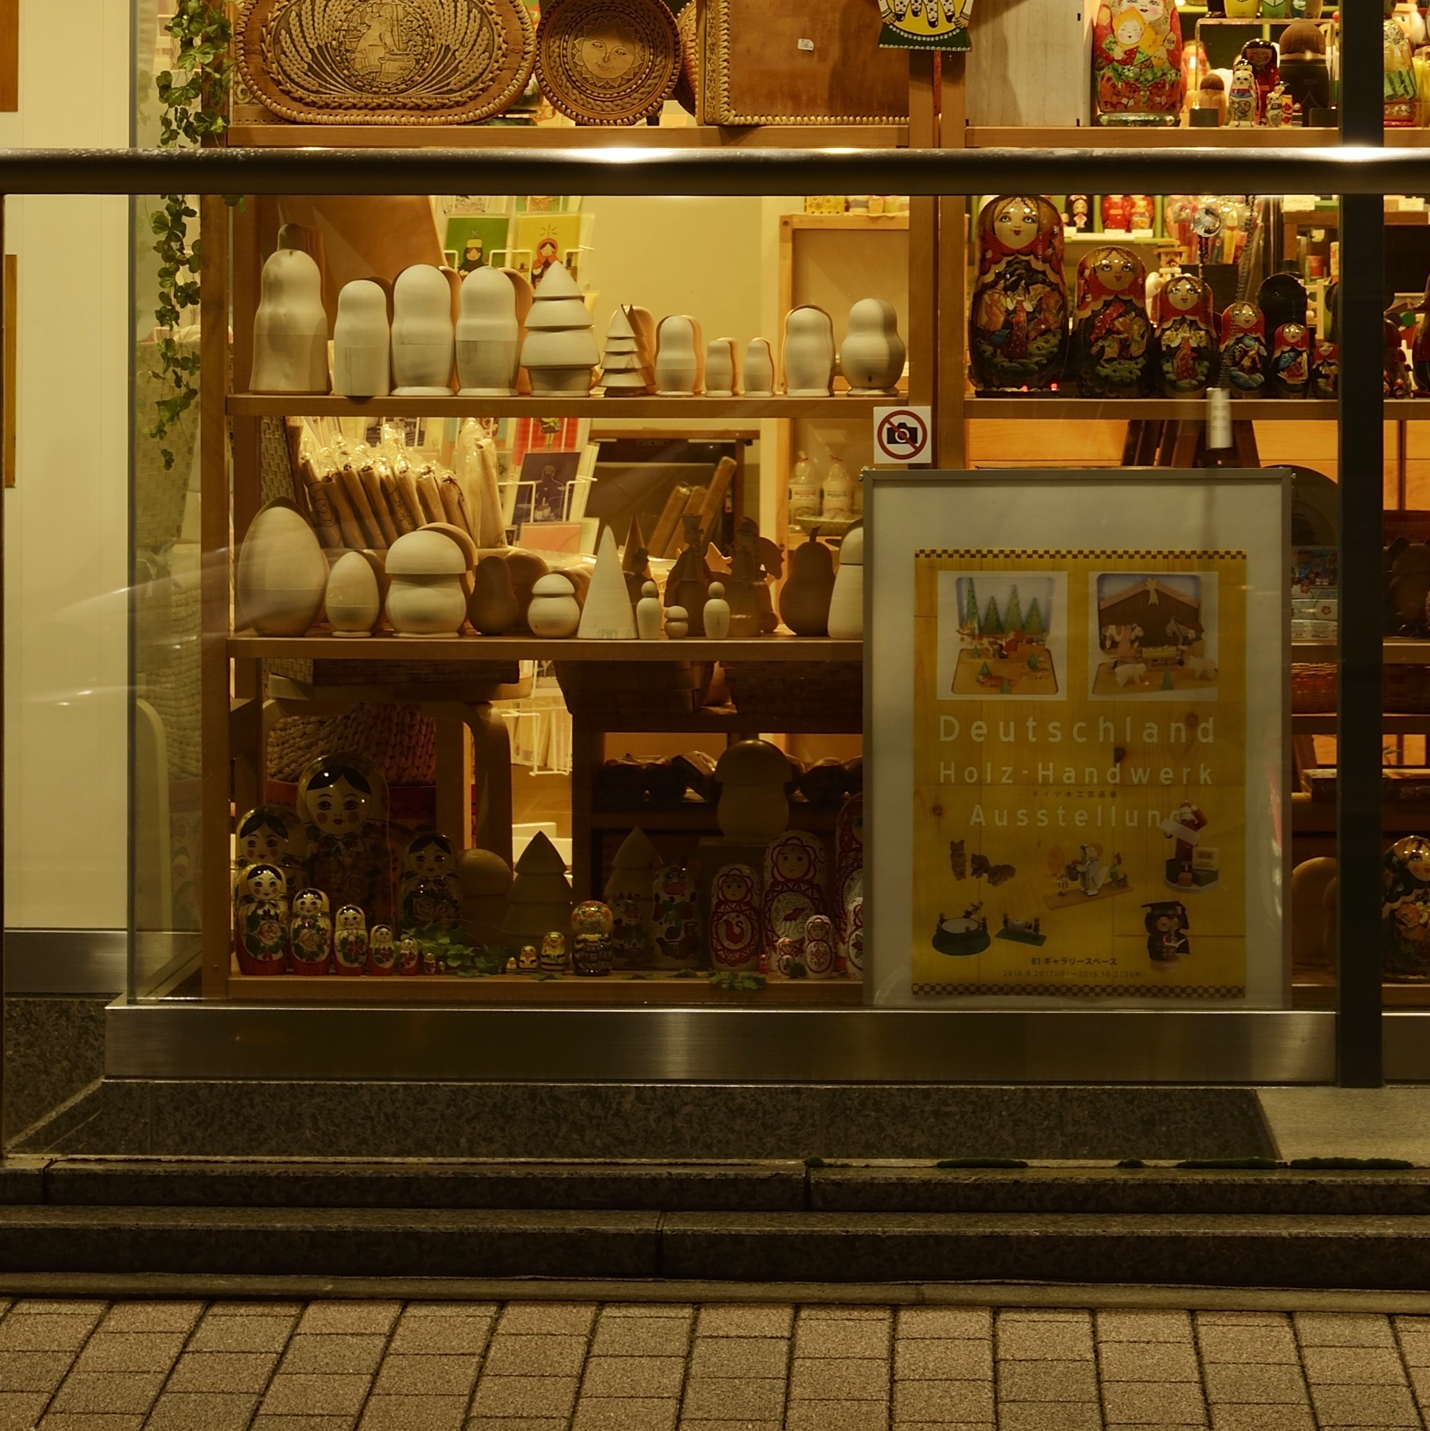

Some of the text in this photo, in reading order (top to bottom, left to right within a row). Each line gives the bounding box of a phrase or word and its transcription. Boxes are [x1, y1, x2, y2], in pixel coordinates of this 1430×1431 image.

[939, 715, 1215, 743] Deutschland
[939, 761, 1213, 785] Holz-Handwerk
[1031, 957, 1118, 966] B1 ギャラリースペース
